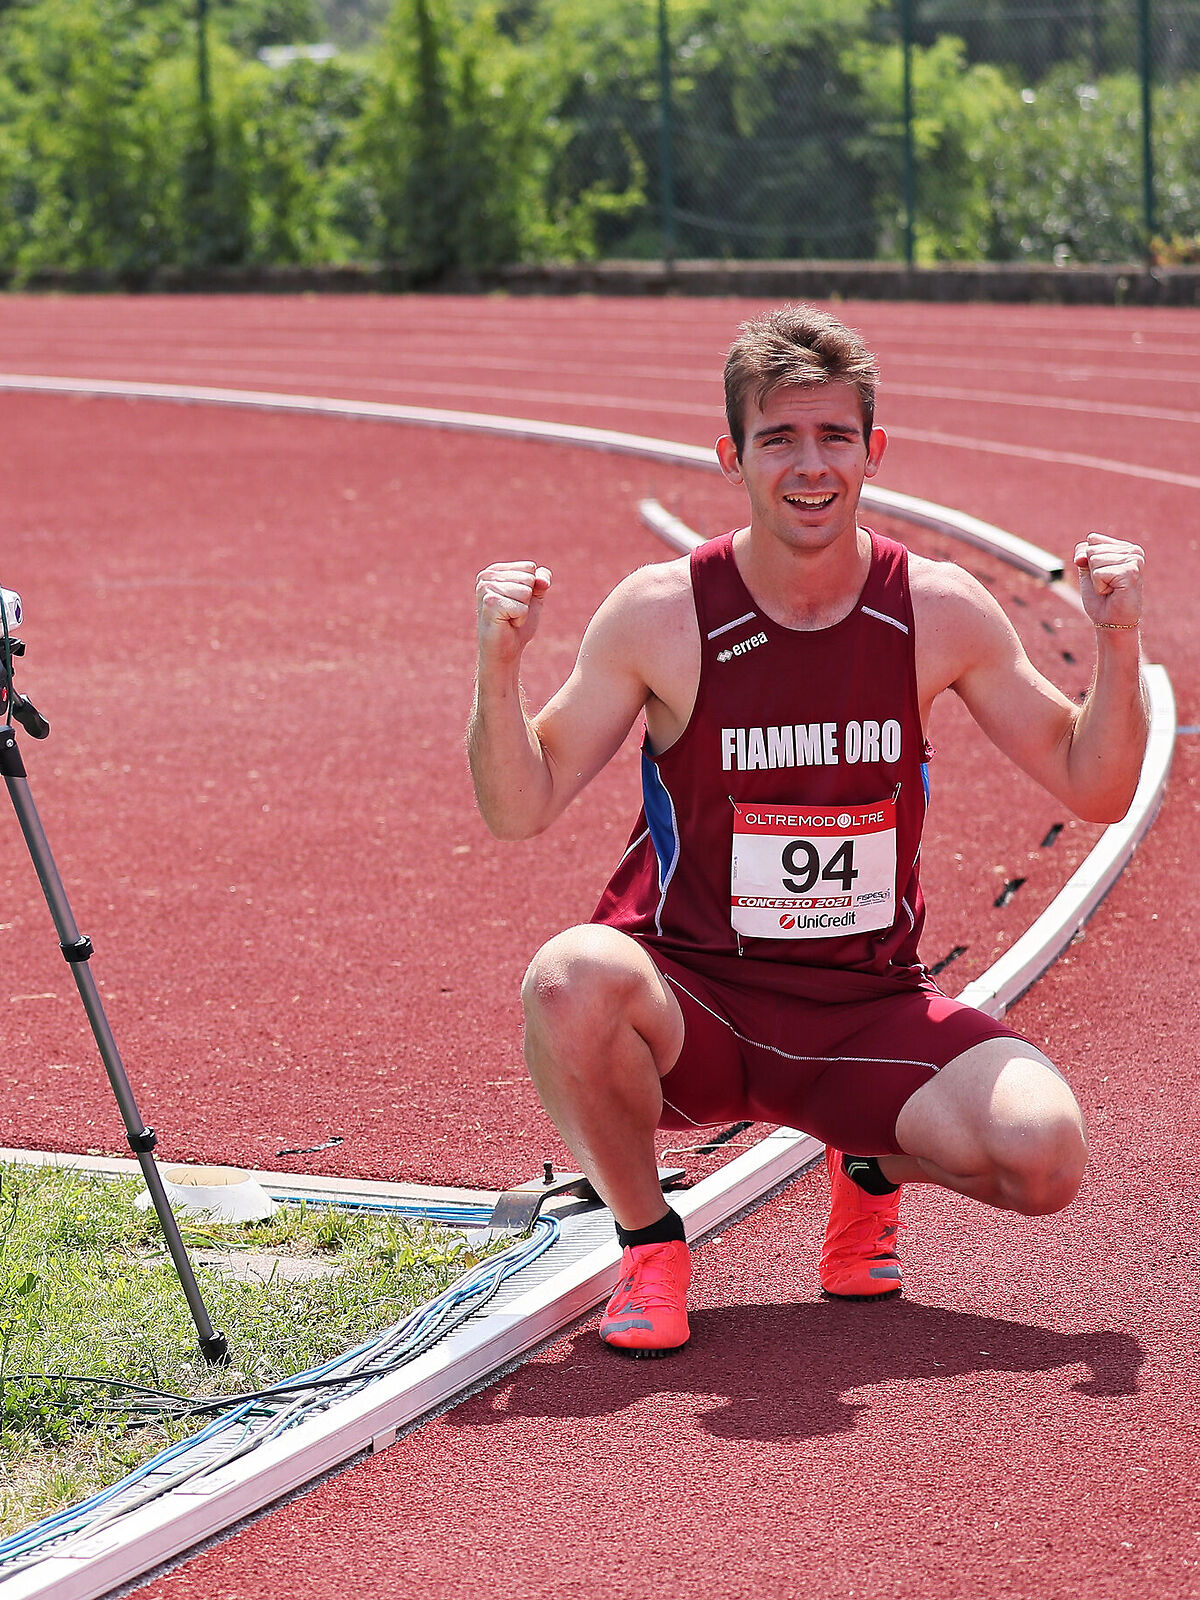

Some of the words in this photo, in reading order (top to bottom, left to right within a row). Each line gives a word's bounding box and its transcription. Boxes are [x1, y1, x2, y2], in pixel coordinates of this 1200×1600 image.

[732, 631, 768, 656] errea
[721, 723, 839, 771] FIAMME
[845, 719, 902, 764] ORO
[781, 839, 858, 894] 94
[737, 897, 813, 909] CONCESIO
[814, 897, 850, 908] 2021
[797, 911, 857, 930] UniCredit
